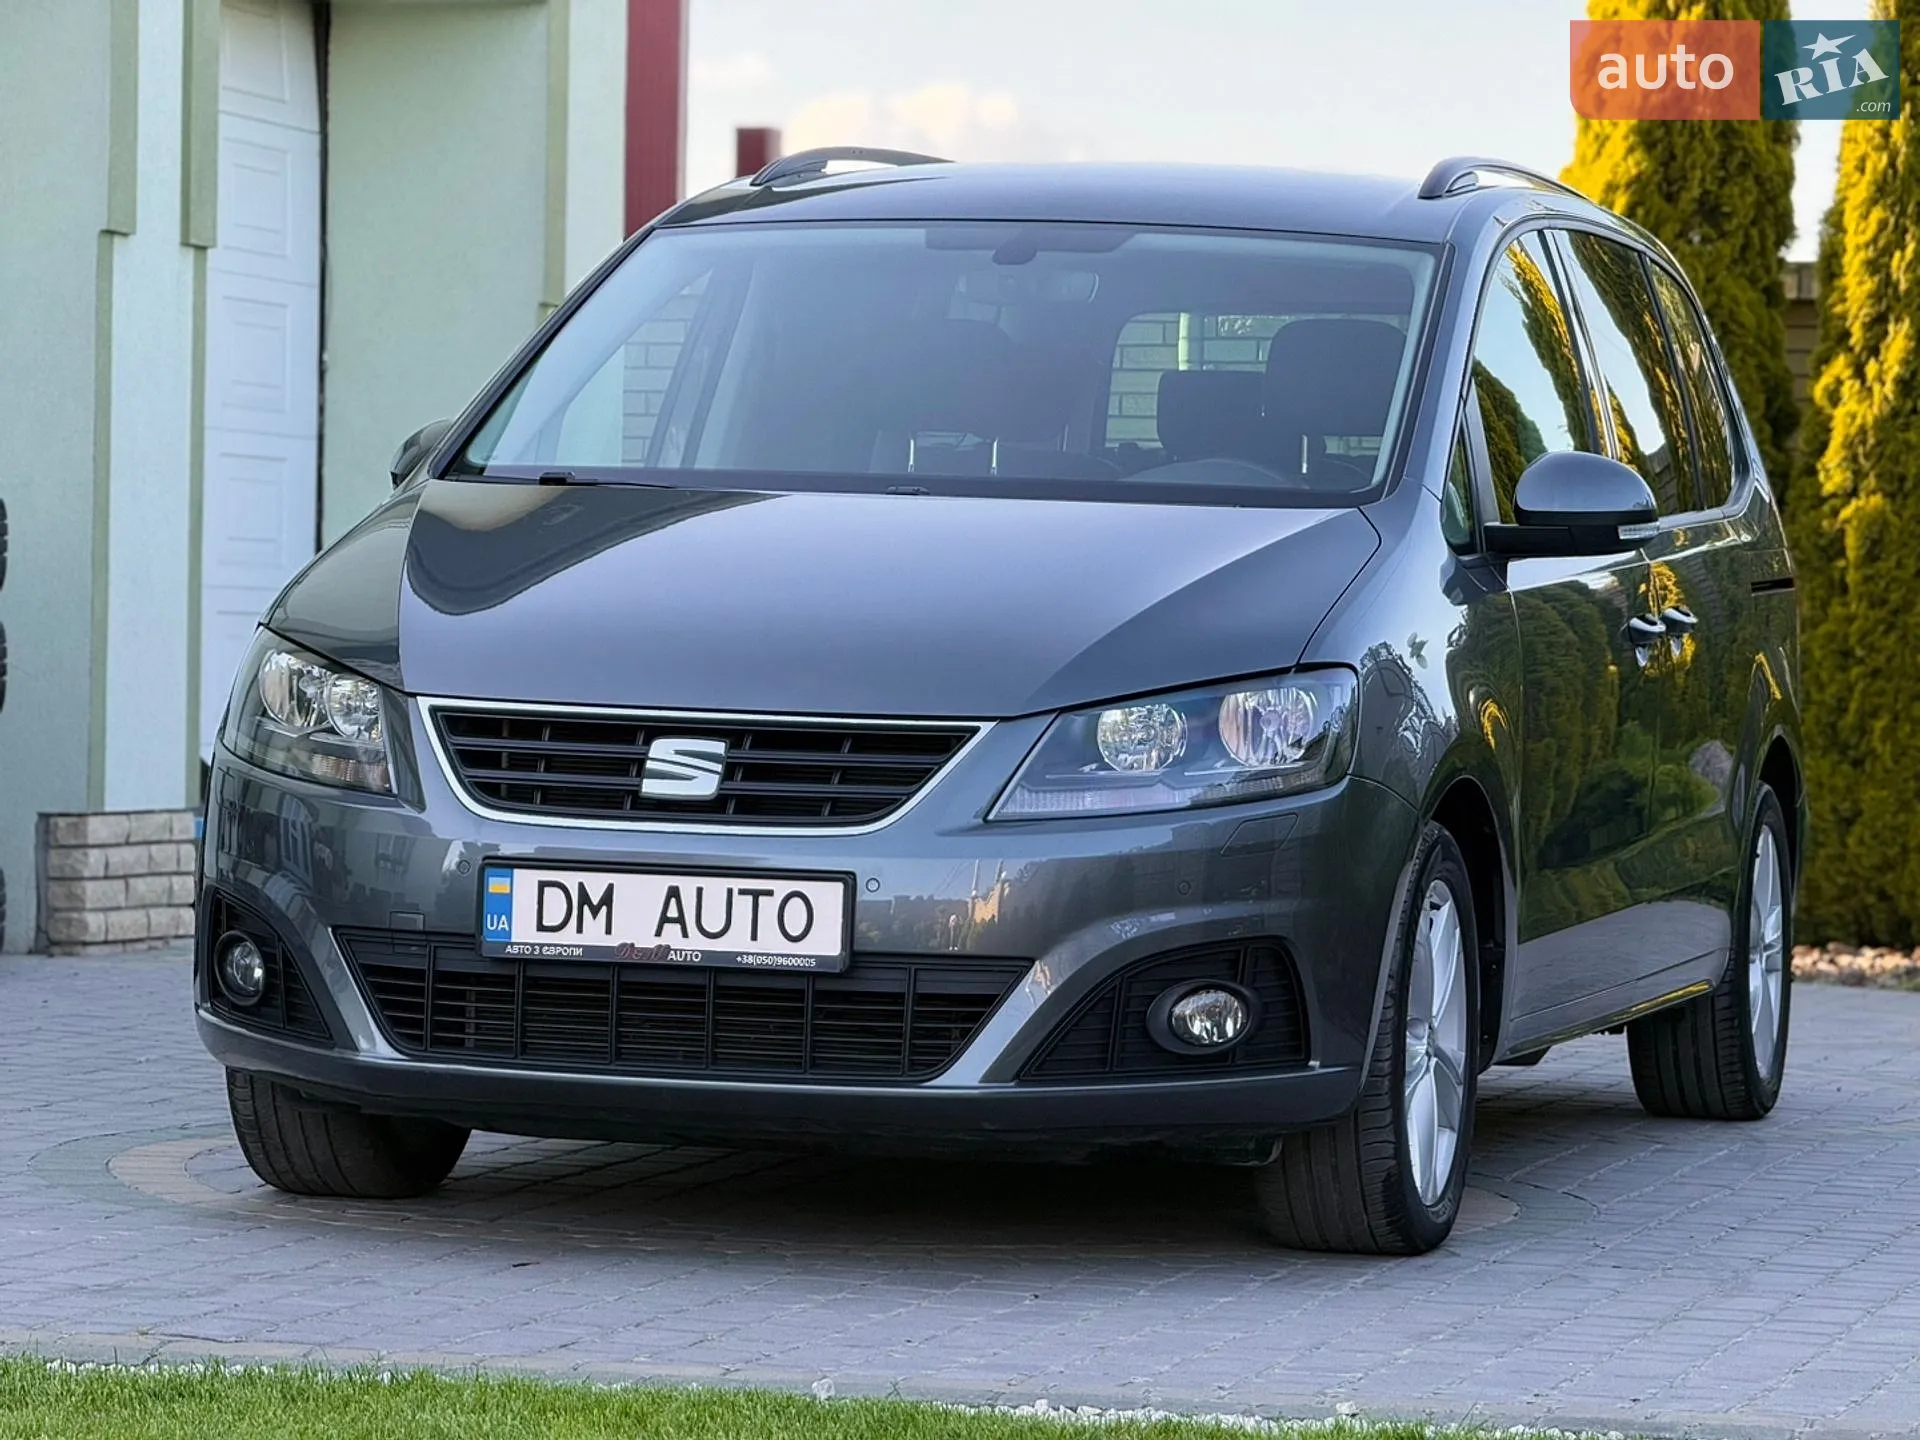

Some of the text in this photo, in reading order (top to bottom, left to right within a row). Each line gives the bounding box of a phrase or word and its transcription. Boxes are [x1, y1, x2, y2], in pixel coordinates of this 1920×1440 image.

[536, 879, 815, 943] DM AUTO
[486, 913, 510, 932] UA
[505, 944, 532, 955] АВТО
[542, 946, 583, 957] ЄВРОПИ
[667, 950, 702, 962] AUTO
